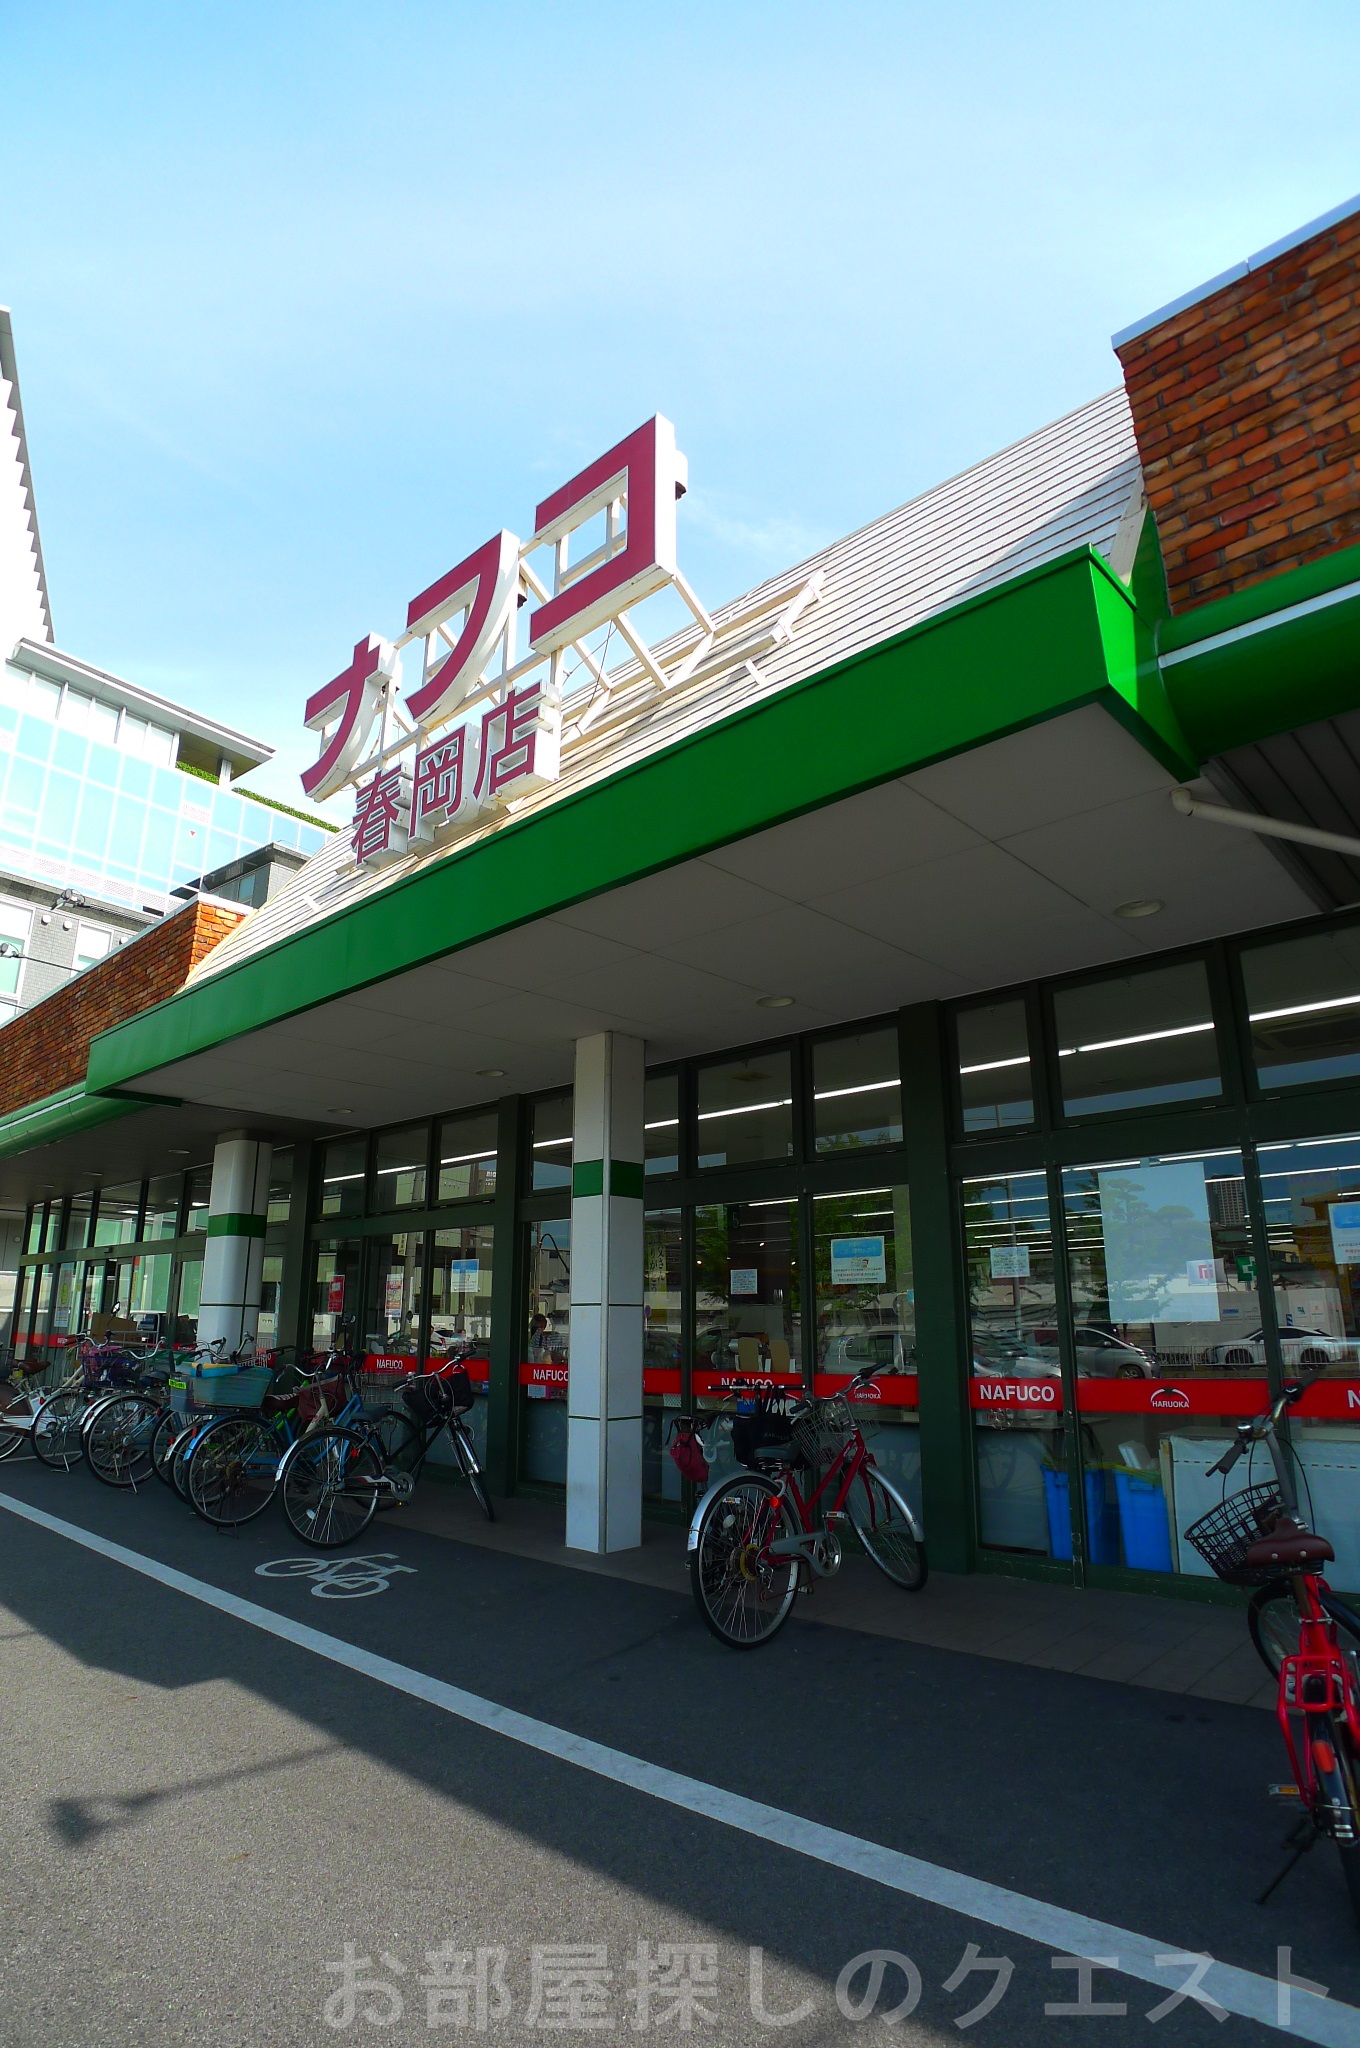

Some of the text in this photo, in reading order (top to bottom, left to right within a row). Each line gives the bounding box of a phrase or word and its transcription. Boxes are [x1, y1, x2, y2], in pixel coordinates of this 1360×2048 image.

[300, 414, 664, 799] ナフコ
[350, 681, 551, 867] 春岡店
[979, 1385, 1055, 1403] NAFUCO
[1152, 1399, 1190, 1409] HARUOKA
